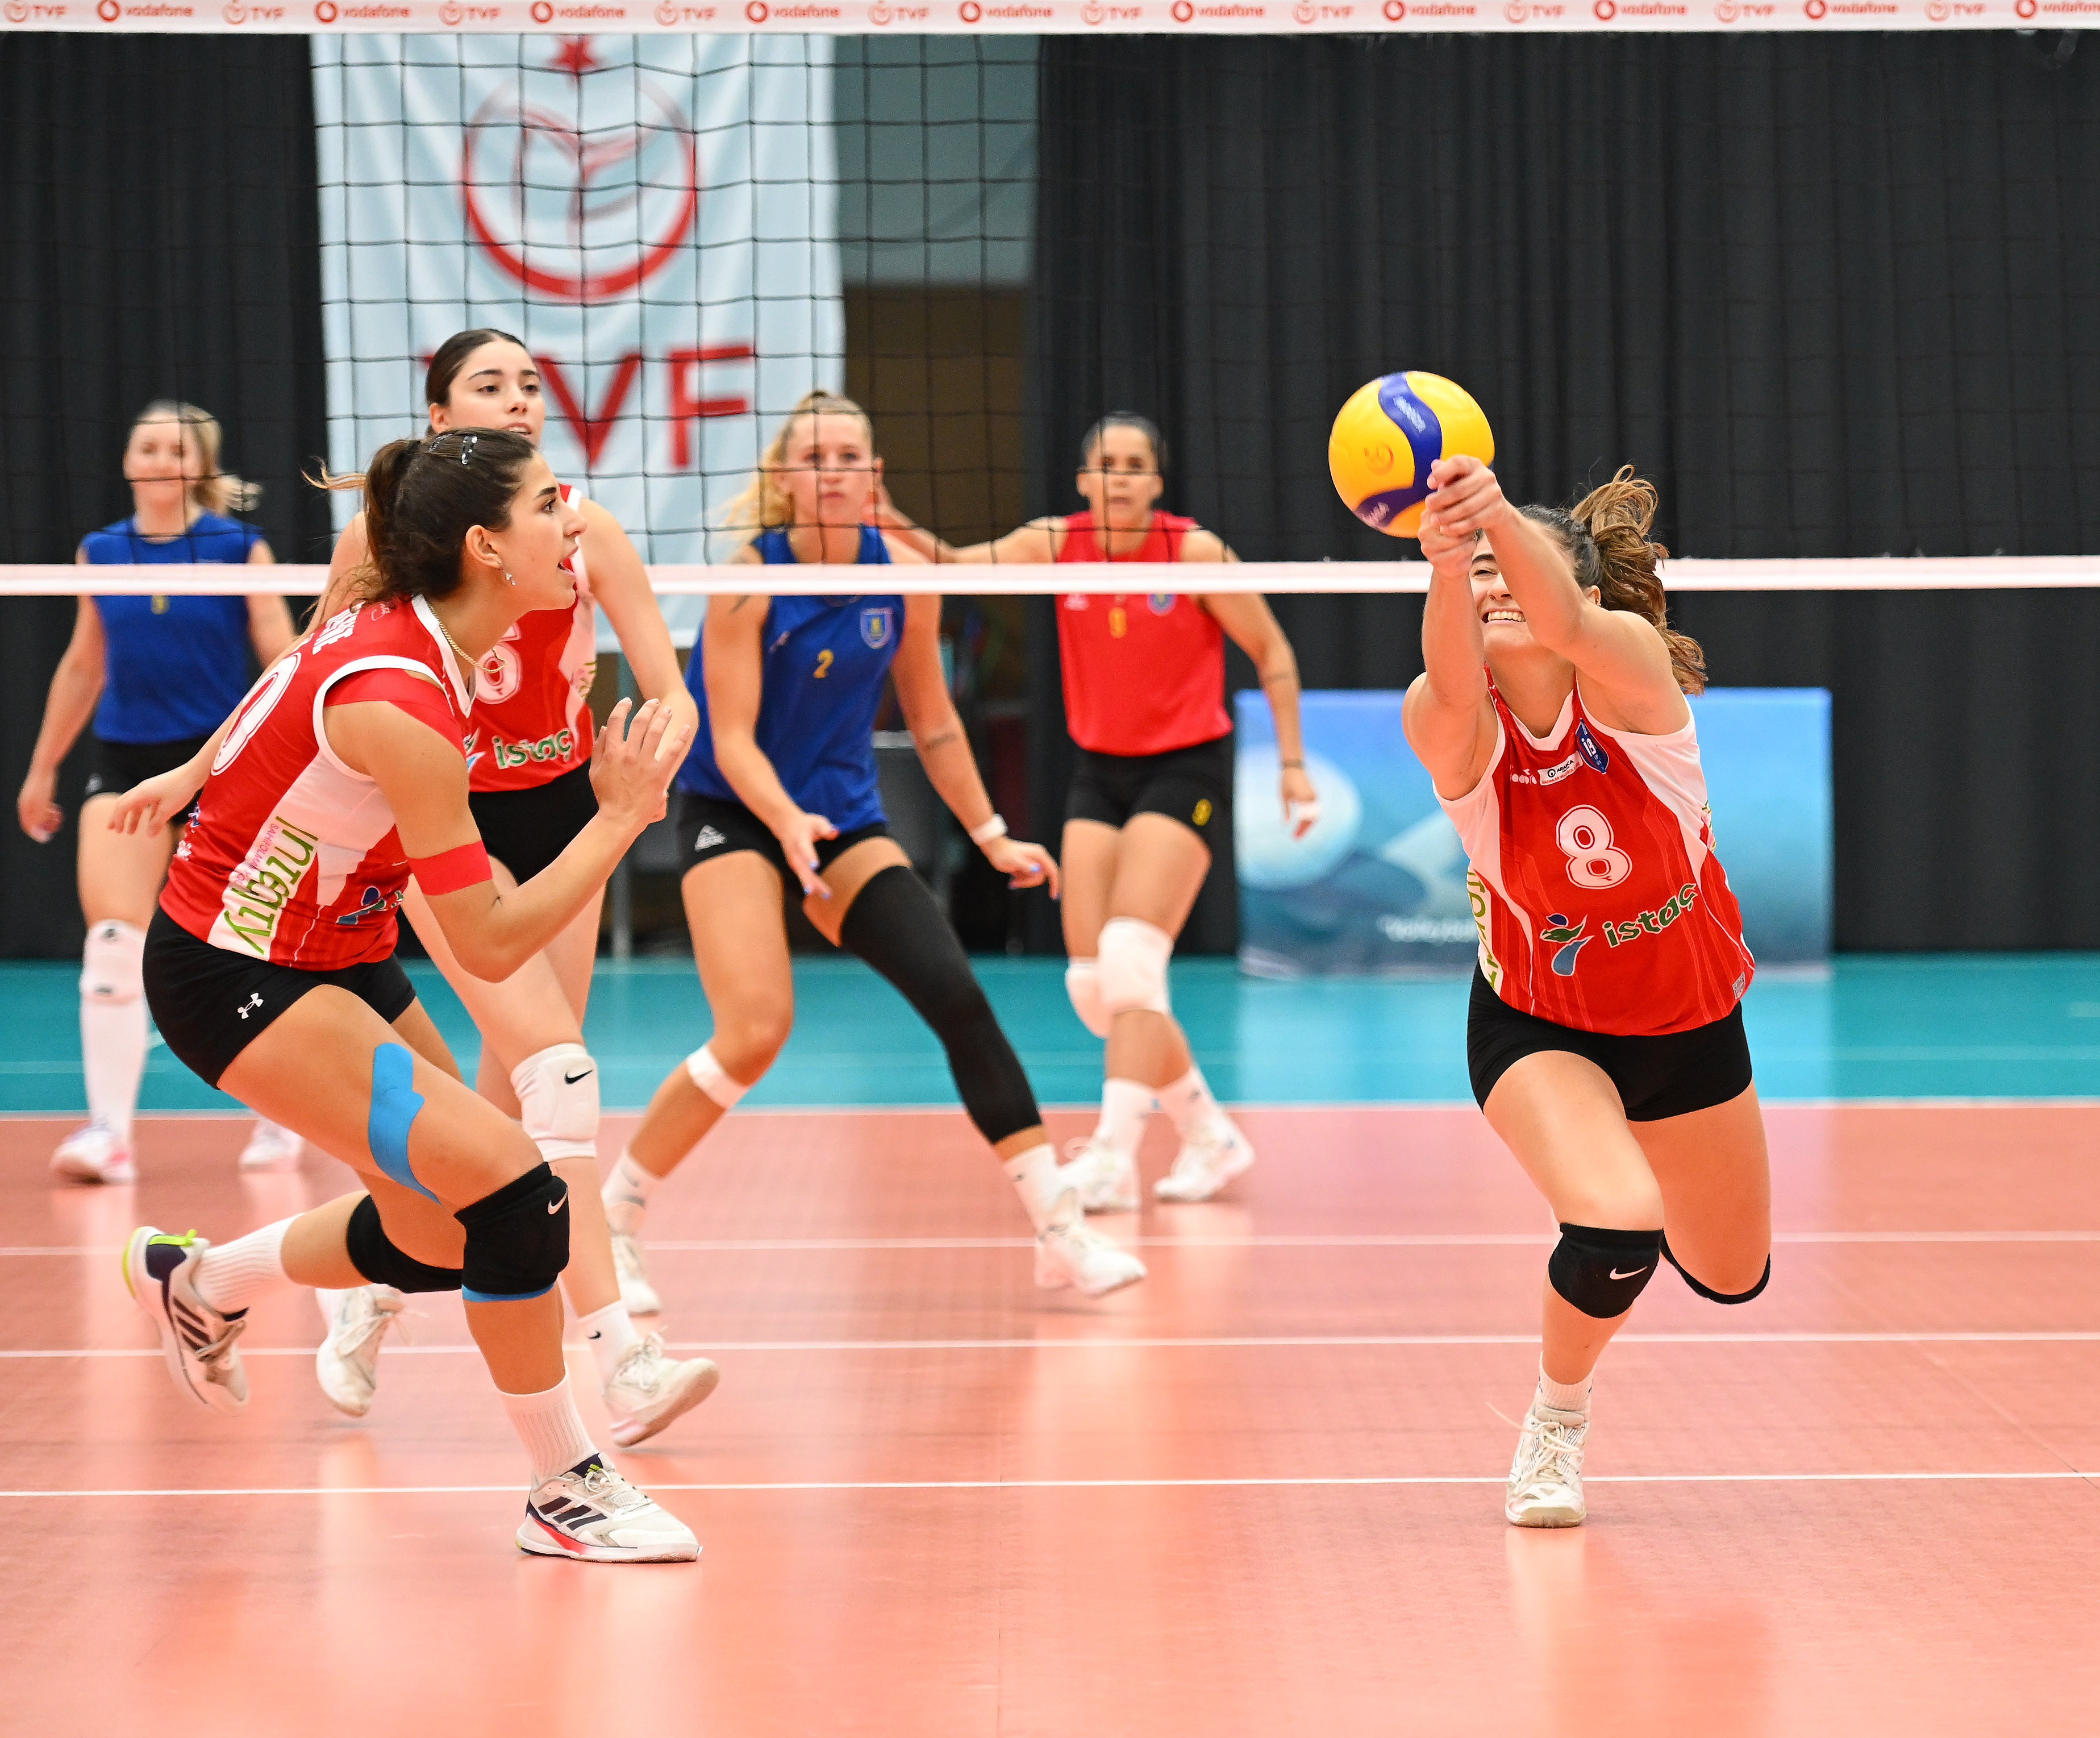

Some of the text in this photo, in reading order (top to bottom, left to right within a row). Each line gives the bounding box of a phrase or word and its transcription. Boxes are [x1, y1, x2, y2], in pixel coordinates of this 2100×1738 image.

[32, 5, 66, 18] TVF
[125, 4, 193, 17] vodafone
[251, 6, 285, 19] TVF
[342, 5, 410, 18] vodafone
[467, 7, 500, 20] TVF
[559, 5, 625, 18] vodafone
[684, 7, 715, 20] TVF
[773, 5, 840, 18] vodafone
[897, 7, 928, 20] TVF
[987, 5, 1053, 18] vodafone
[2045, 1, 2100, 13] vodafon
[423, 343, 756, 468] VF
[813, 648, 835, 679] 2
[1556, 804, 1634, 889] 8
[1601, 882, 1699, 949] istaç
